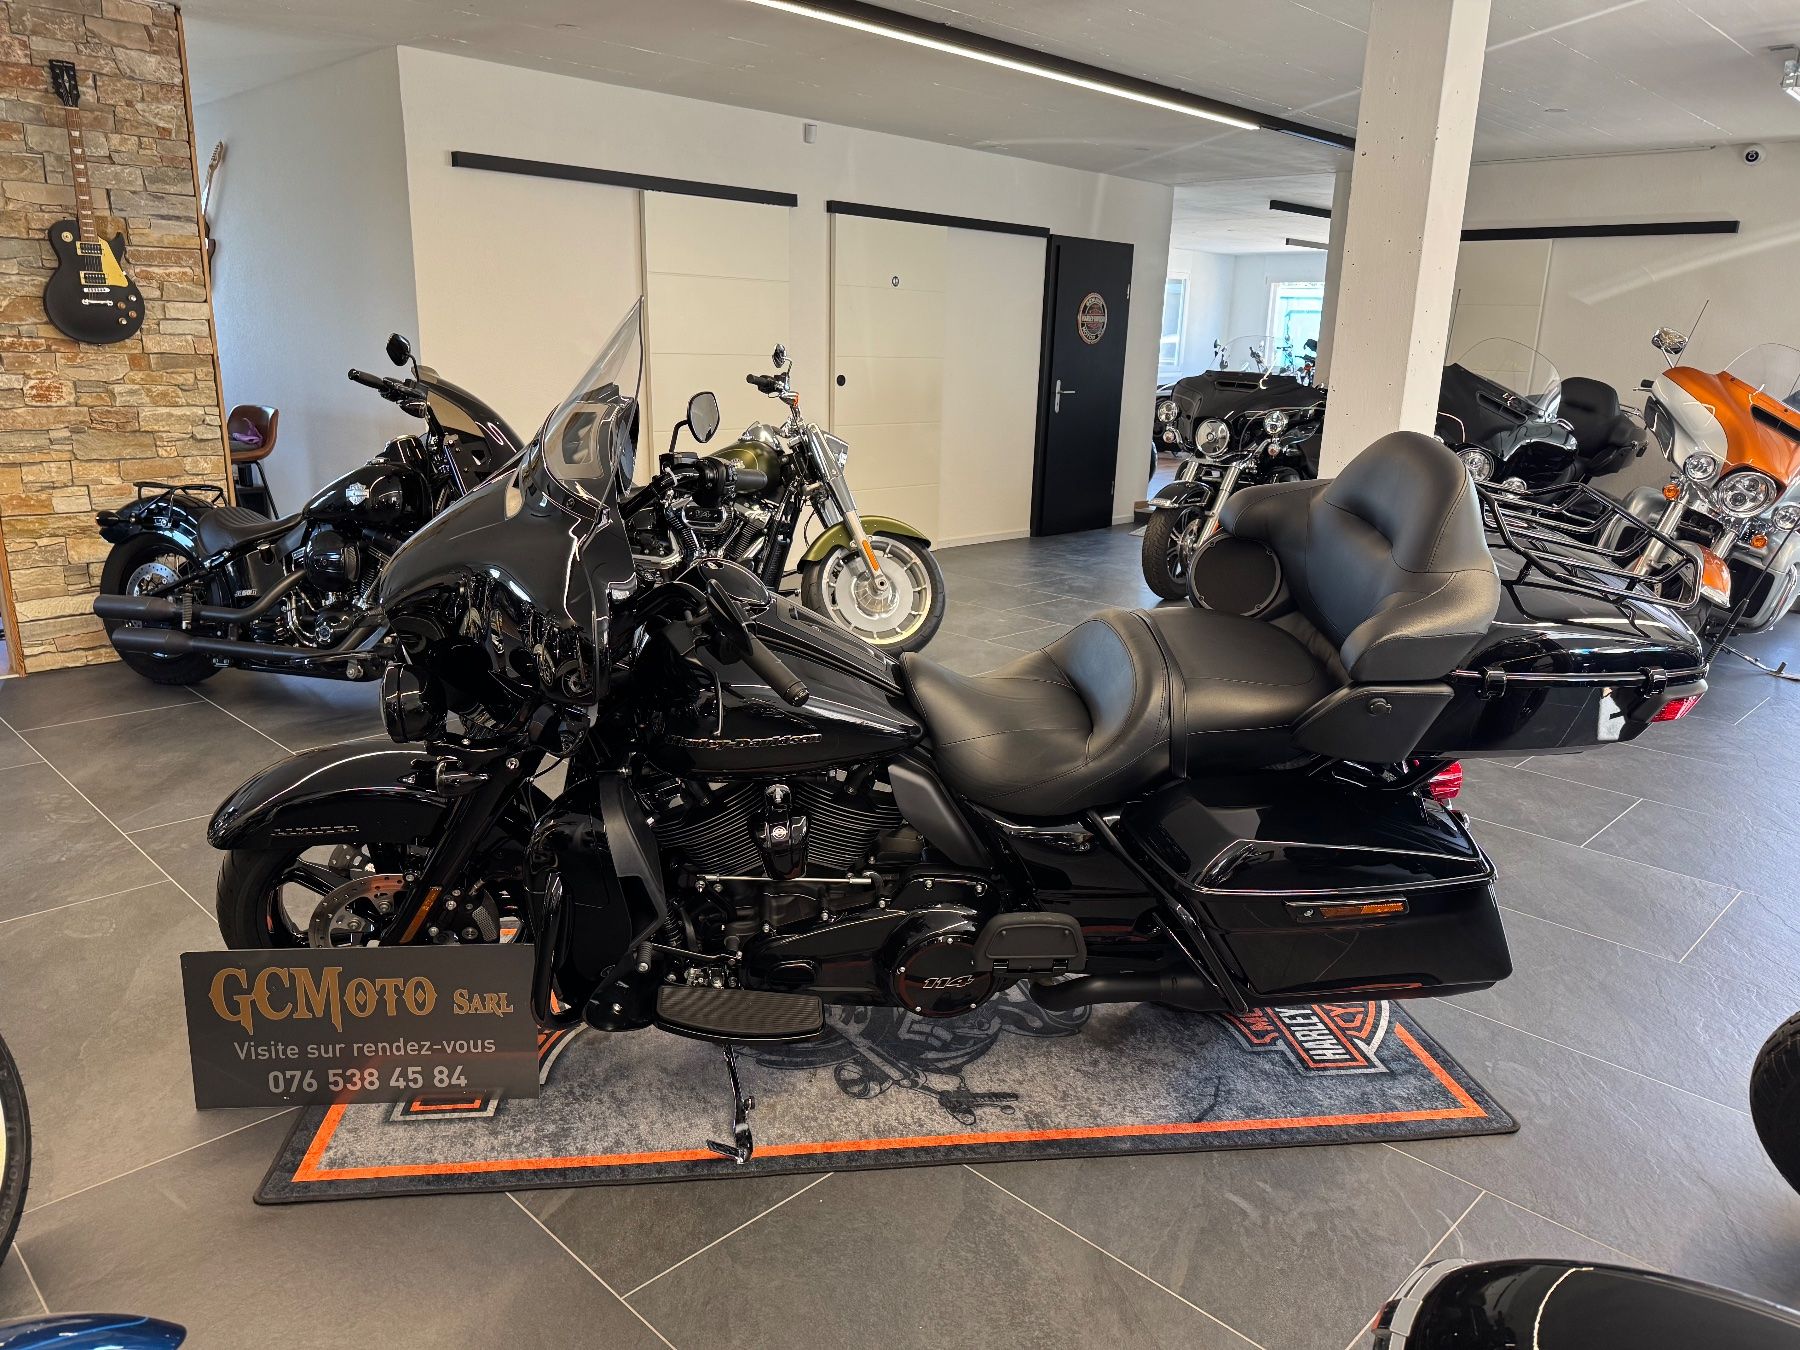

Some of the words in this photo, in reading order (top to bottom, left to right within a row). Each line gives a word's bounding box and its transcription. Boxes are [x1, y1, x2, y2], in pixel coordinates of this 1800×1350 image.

[922, 974, 975, 989] 114
[1274, 1007, 1351, 1060] HARLEY
[233, 1040, 299, 1060] Visite
[306, 1042, 343, 1059] sur
[352, 1038, 497, 1058] rendez-vous
[267, 1070, 319, 1093] 076
[328, 1068, 380, 1092] 538
[389, 1066, 424, 1089] 45
[433, 1064, 468, 1087] 84
